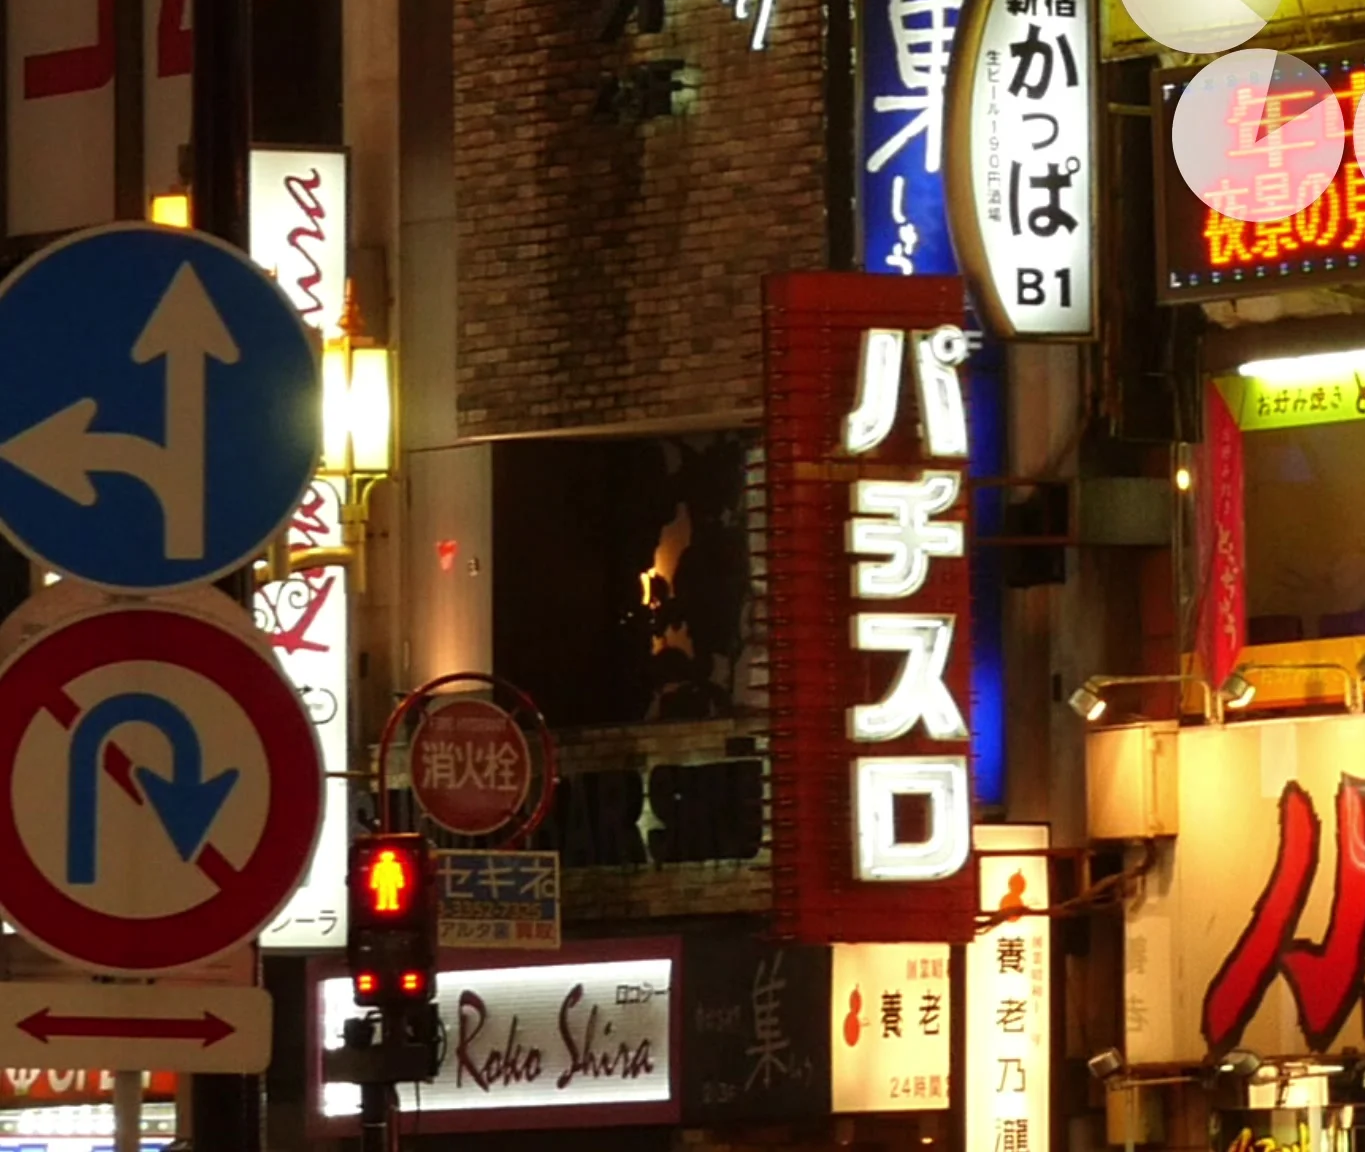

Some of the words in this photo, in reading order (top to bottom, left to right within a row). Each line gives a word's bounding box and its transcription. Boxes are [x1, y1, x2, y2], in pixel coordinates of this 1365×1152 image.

[1007, 24, 1082, 238] かっぱ
[1016, 267, 1073, 309] B1
[1257, 386, 1344, 416] お好み焼き
[842, 324, 970, 882] パチスロ
[421, 739, 521, 792] 消火栓
[881, 989, 941, 1039] 養老
